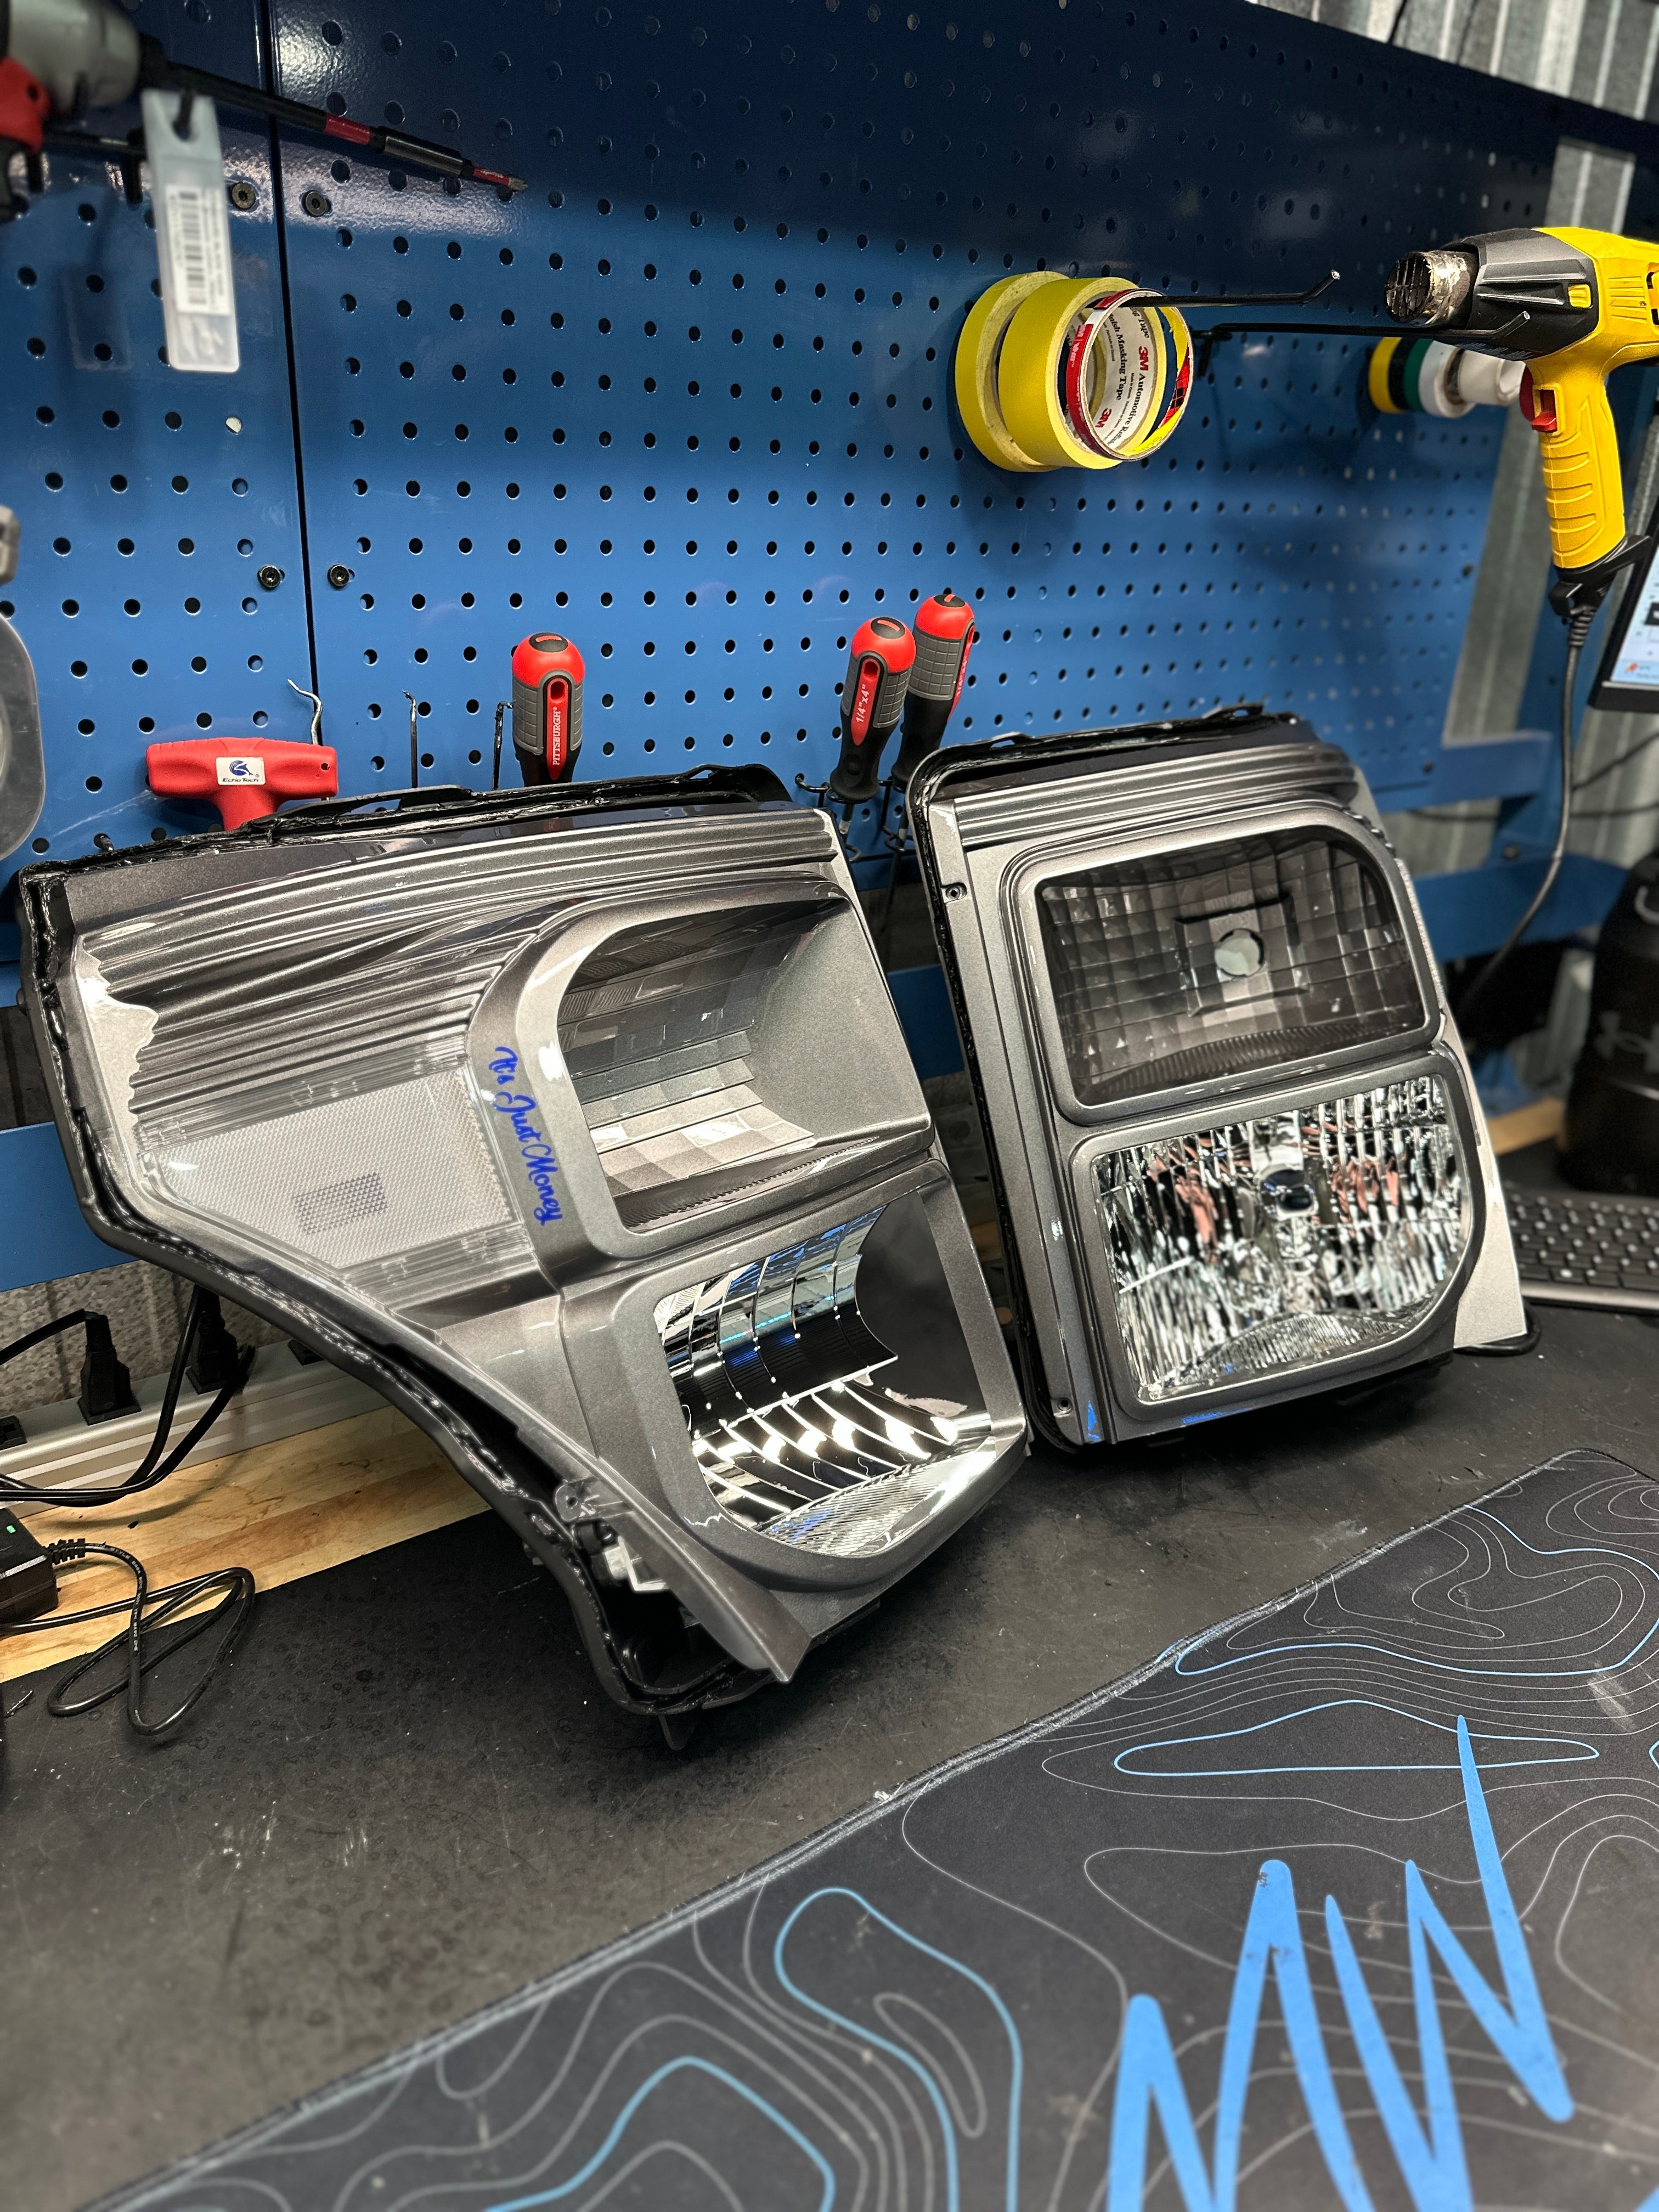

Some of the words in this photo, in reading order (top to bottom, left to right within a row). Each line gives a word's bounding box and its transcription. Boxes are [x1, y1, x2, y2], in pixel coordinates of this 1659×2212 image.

[1138, 318, 1149, 338] Tape
[1116, 334, 1127, 374] Masking
[1139, 346, 1149, 371] 3M
[1116, 376, 1127, 400] Tape
[1125, 373, 1146, 425] Automotive
[1095, 408, 1111, 428] 3M
[856, 684, 870, 723] 1/4"x4"
[493, 1091, 541, 1143] Just
[521, 1143, 563, 1227] Money
